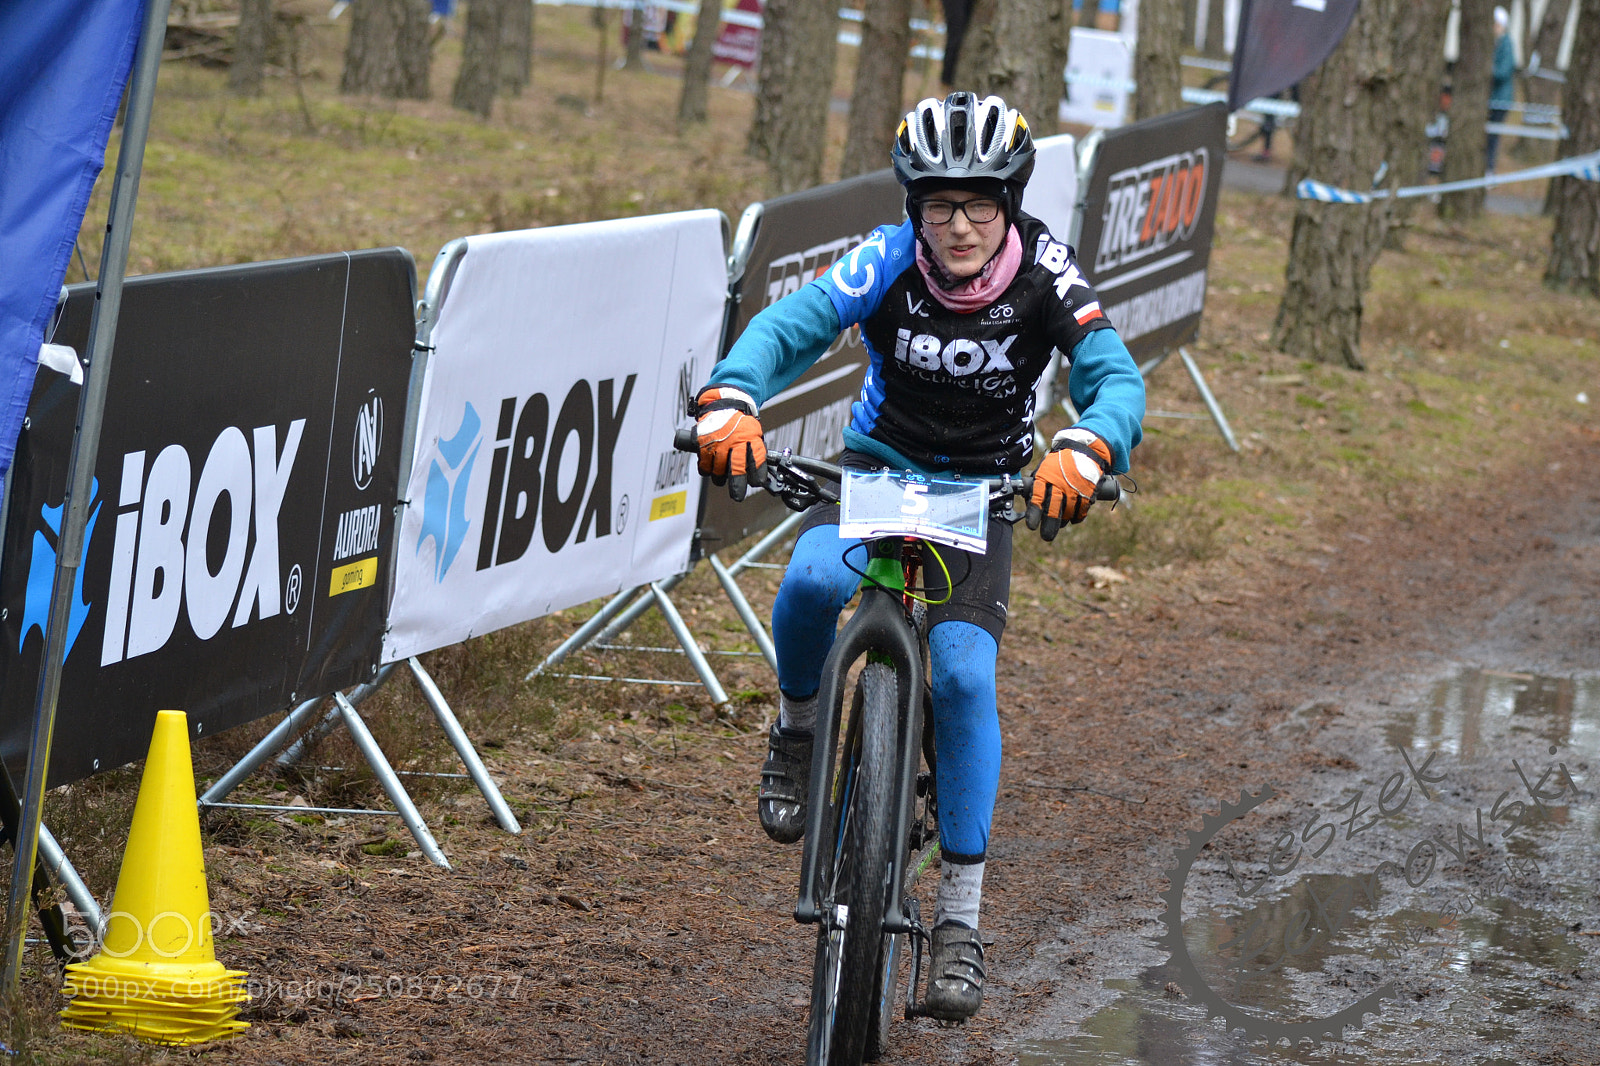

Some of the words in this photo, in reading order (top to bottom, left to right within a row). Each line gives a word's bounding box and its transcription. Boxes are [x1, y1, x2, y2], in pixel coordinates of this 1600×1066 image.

[1033, 233, 1090, 301] iBX
[895, 328, 1018, 378] iBOX
[476, 373, 638, 571] iBOX
[900, 483, 929, 515] 5
[101, 418, 307, 667] iBOX
[333, 504, 382, 561] AURORA
[341, 566, 363, 589] gaming
